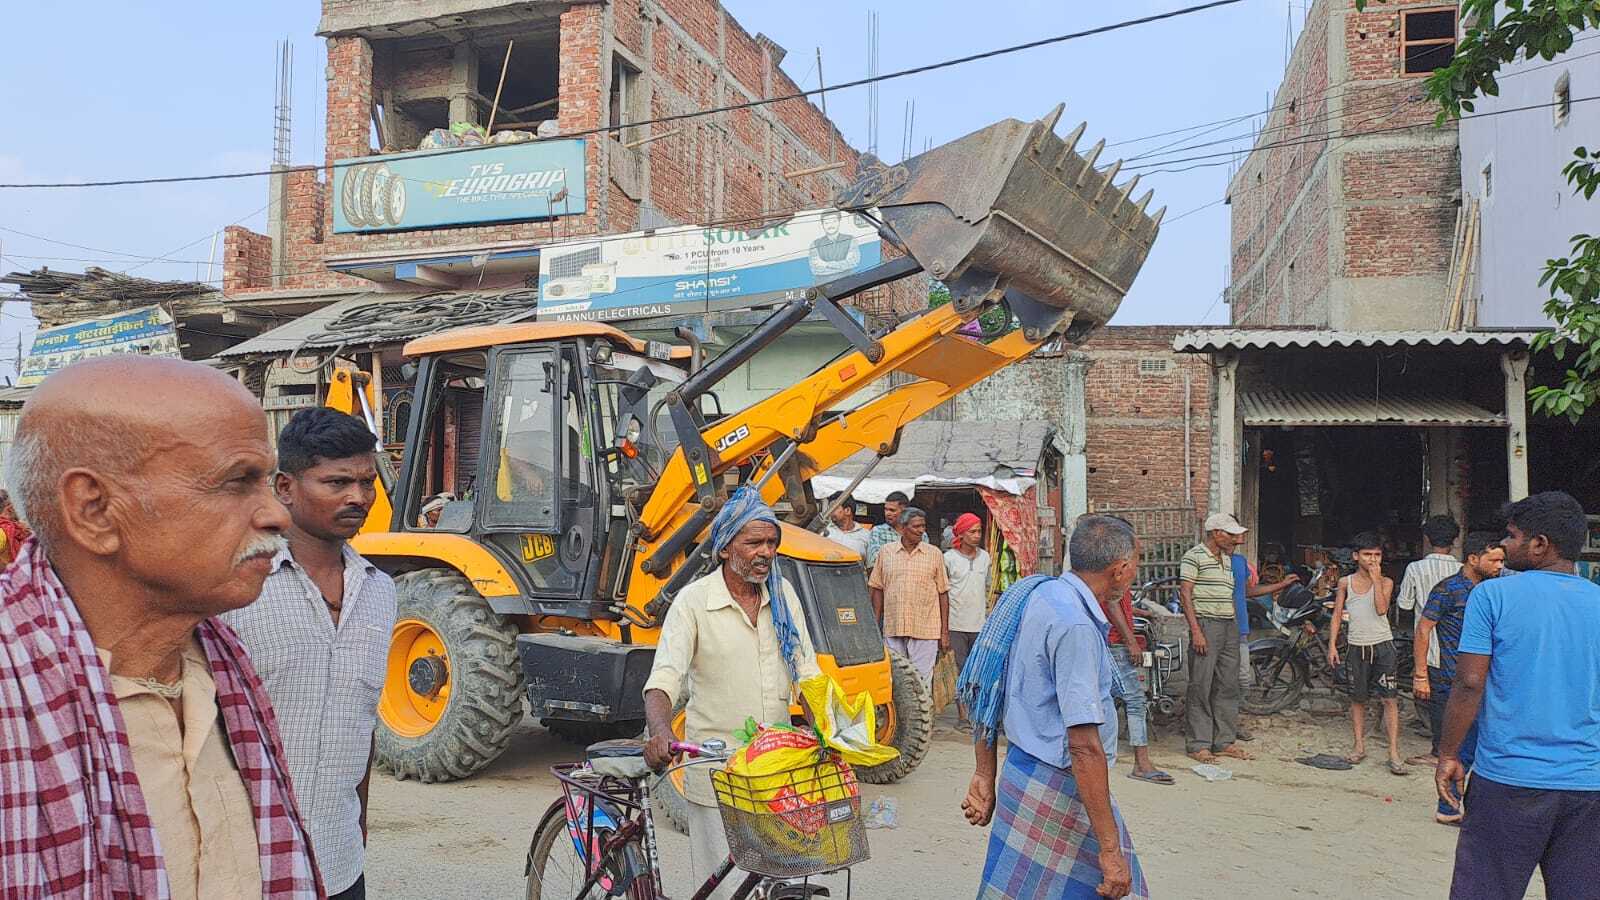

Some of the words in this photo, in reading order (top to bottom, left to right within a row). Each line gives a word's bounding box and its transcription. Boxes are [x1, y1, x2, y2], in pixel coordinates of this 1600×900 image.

[470, 162, 504, 177] TVS
[443, 168, 568, 197] EUROGRIP
[691, 250, 709, 259] PCU
[710, 248, 730, 257] from
[742, 244, 765, 253] Years
[557, 310, 596, 321] MANNU
[598, 304, 672, 320] ELECTRICALS
[716, 424, 750, 452] JCB
[523, 534, 552, 560] JCB
